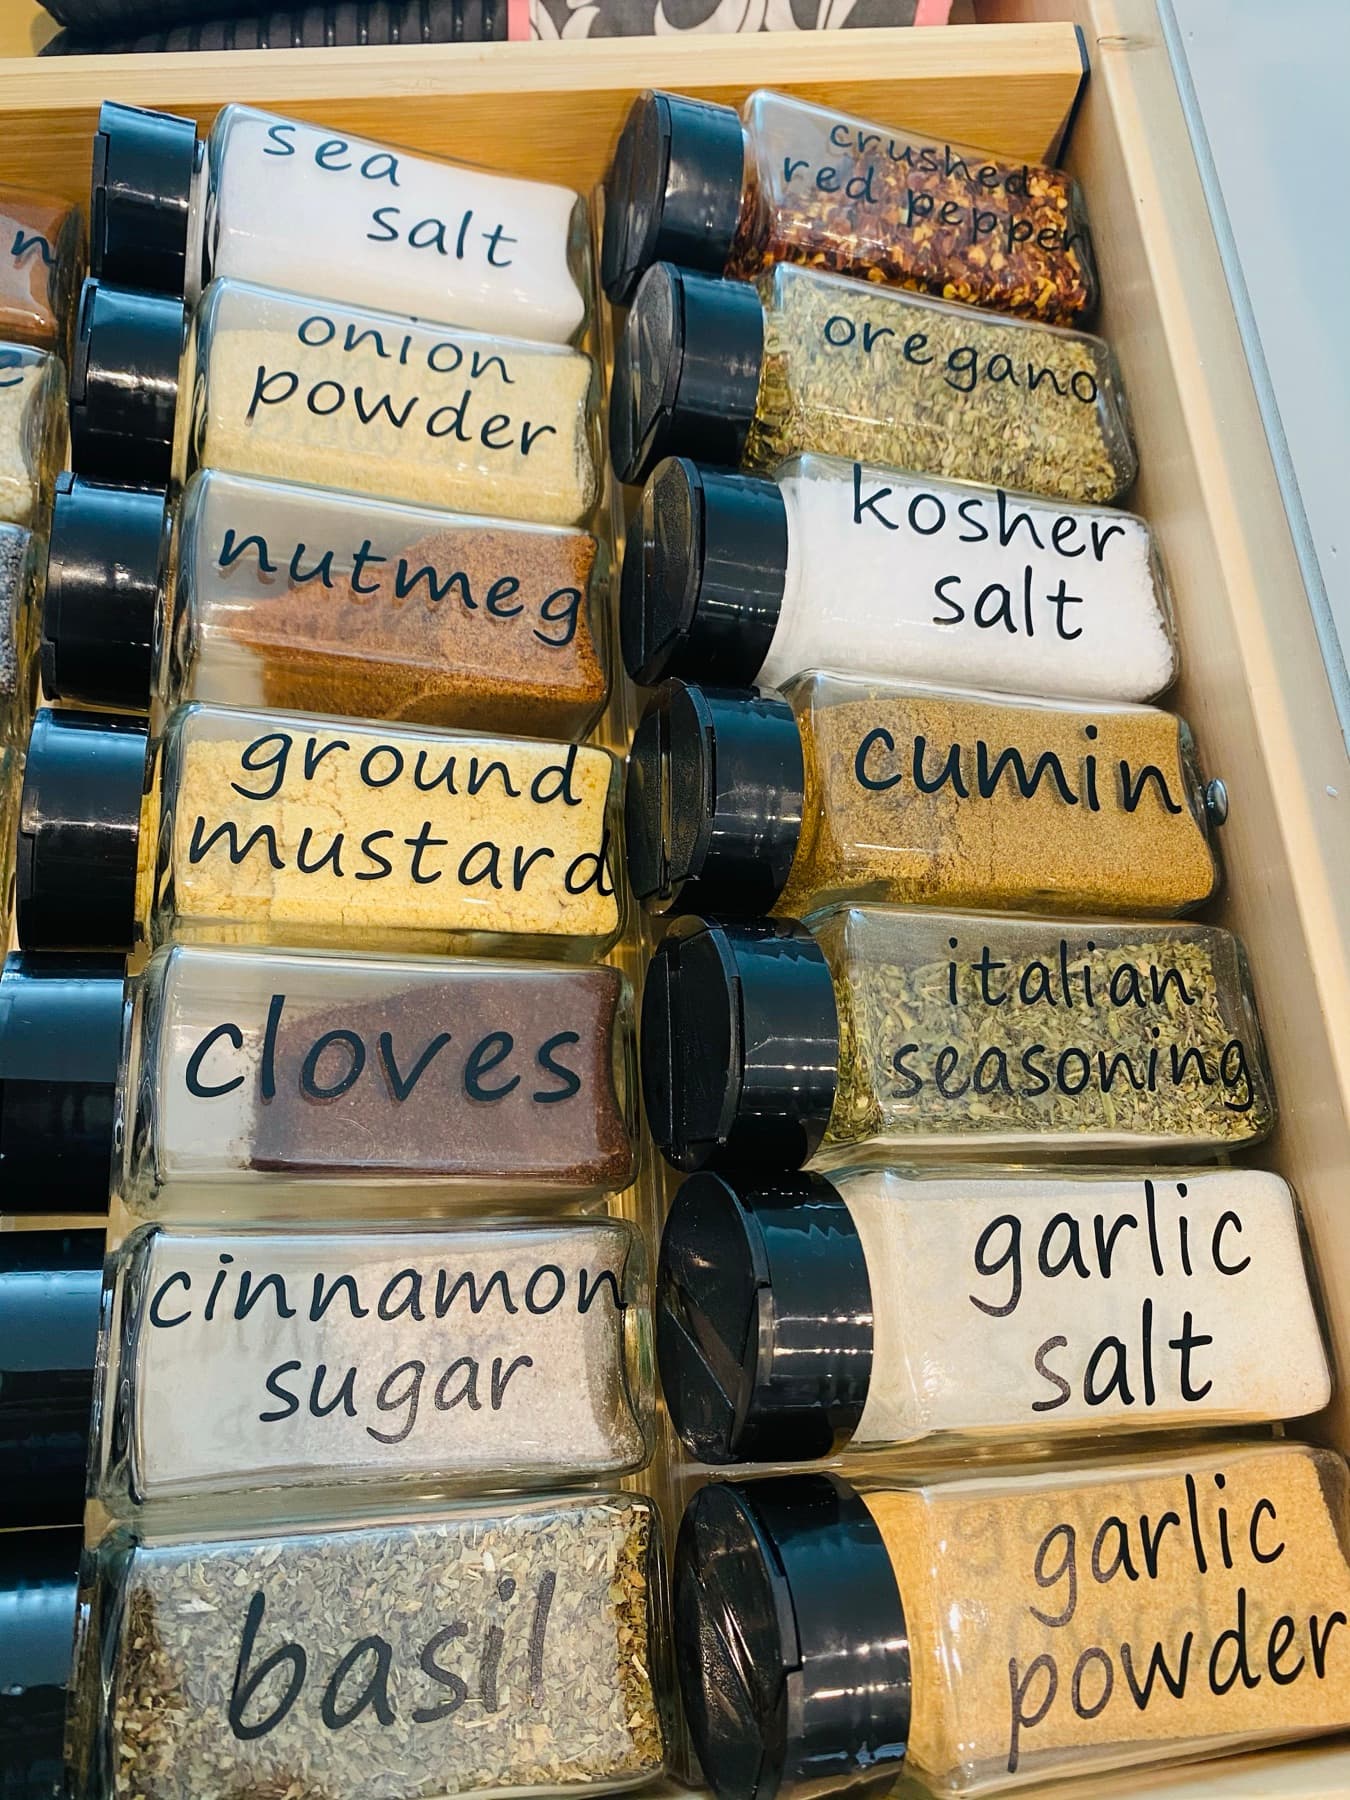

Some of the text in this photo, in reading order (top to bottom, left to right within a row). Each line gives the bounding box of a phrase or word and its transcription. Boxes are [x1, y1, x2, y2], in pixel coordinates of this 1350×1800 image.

[262, 123, 402, 187] sea
[829, 123, 1034, 198] crushed
[366, 206, 518, 268] salt
[783, 154, 1083, 254] red pepper
[297, 315, 515, 384] onion
[823, 314, 1100, 404] oregano
[245, 365, 557, 457] powder
[852, 462, 1126, 562] kosher
[218, 528, 582, 646] nutmeg
[932, 564, 1084, 641] salt
[229, 733, 583, 806] ground
[854, 724, 1182, 815] cumin
[187, 814, 615, 896] mustard
[946, 937, 1196, 1009] italian
[184, 994, 582, 1104] cloves
[890, 1026, 1254, 1112] seasoning
[148, 1253, 628, 1329] cinnamon
[968, 1179, 1252, 1318] garlic
[258, 1355, 533, 1445] sugar
[1031, 1297, 1214, 1413] salt
[1028, 1473, 1286, 1629] garlic
[228, 1570, 559, 1742] basil
[1005, 1588, 1349, 1774] powder
